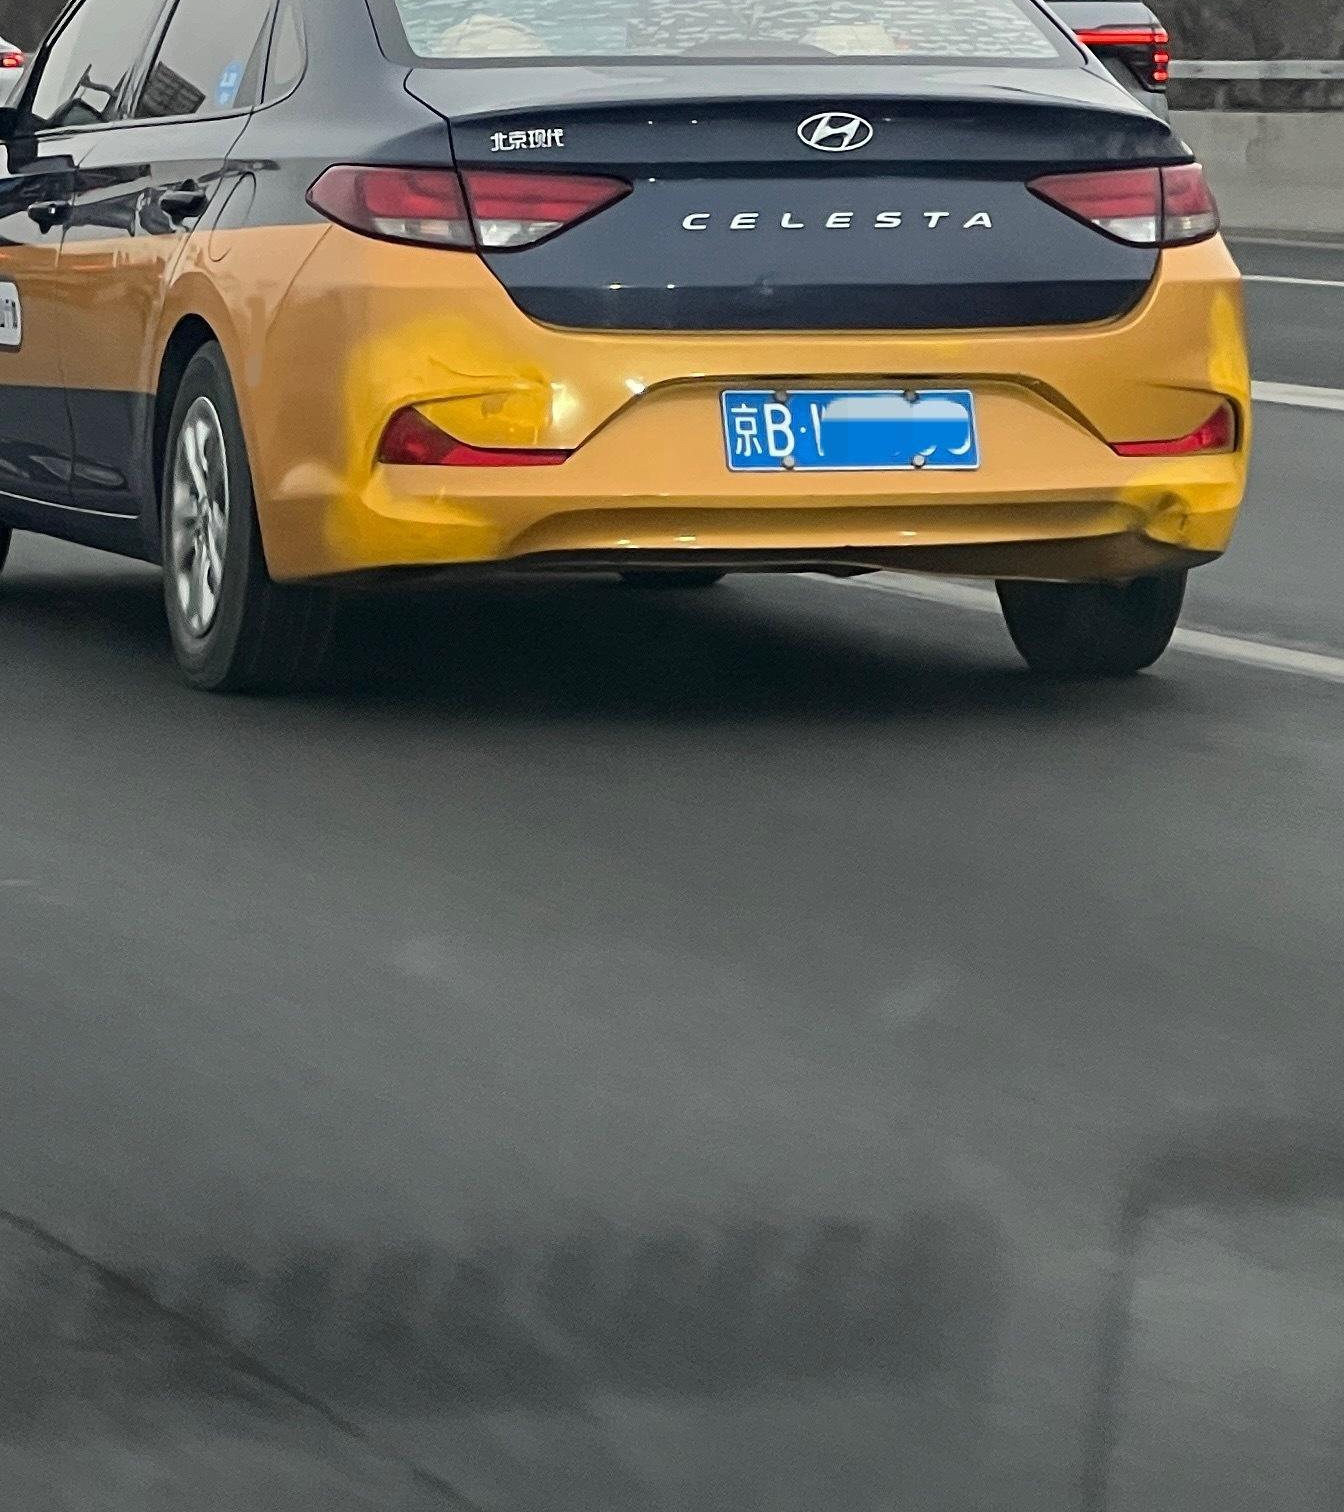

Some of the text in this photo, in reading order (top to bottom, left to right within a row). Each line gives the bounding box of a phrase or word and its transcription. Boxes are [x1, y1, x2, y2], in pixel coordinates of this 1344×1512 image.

[489, 128, 565, 152] 北京现代
[681, 211, 993, 231] CELESTA
